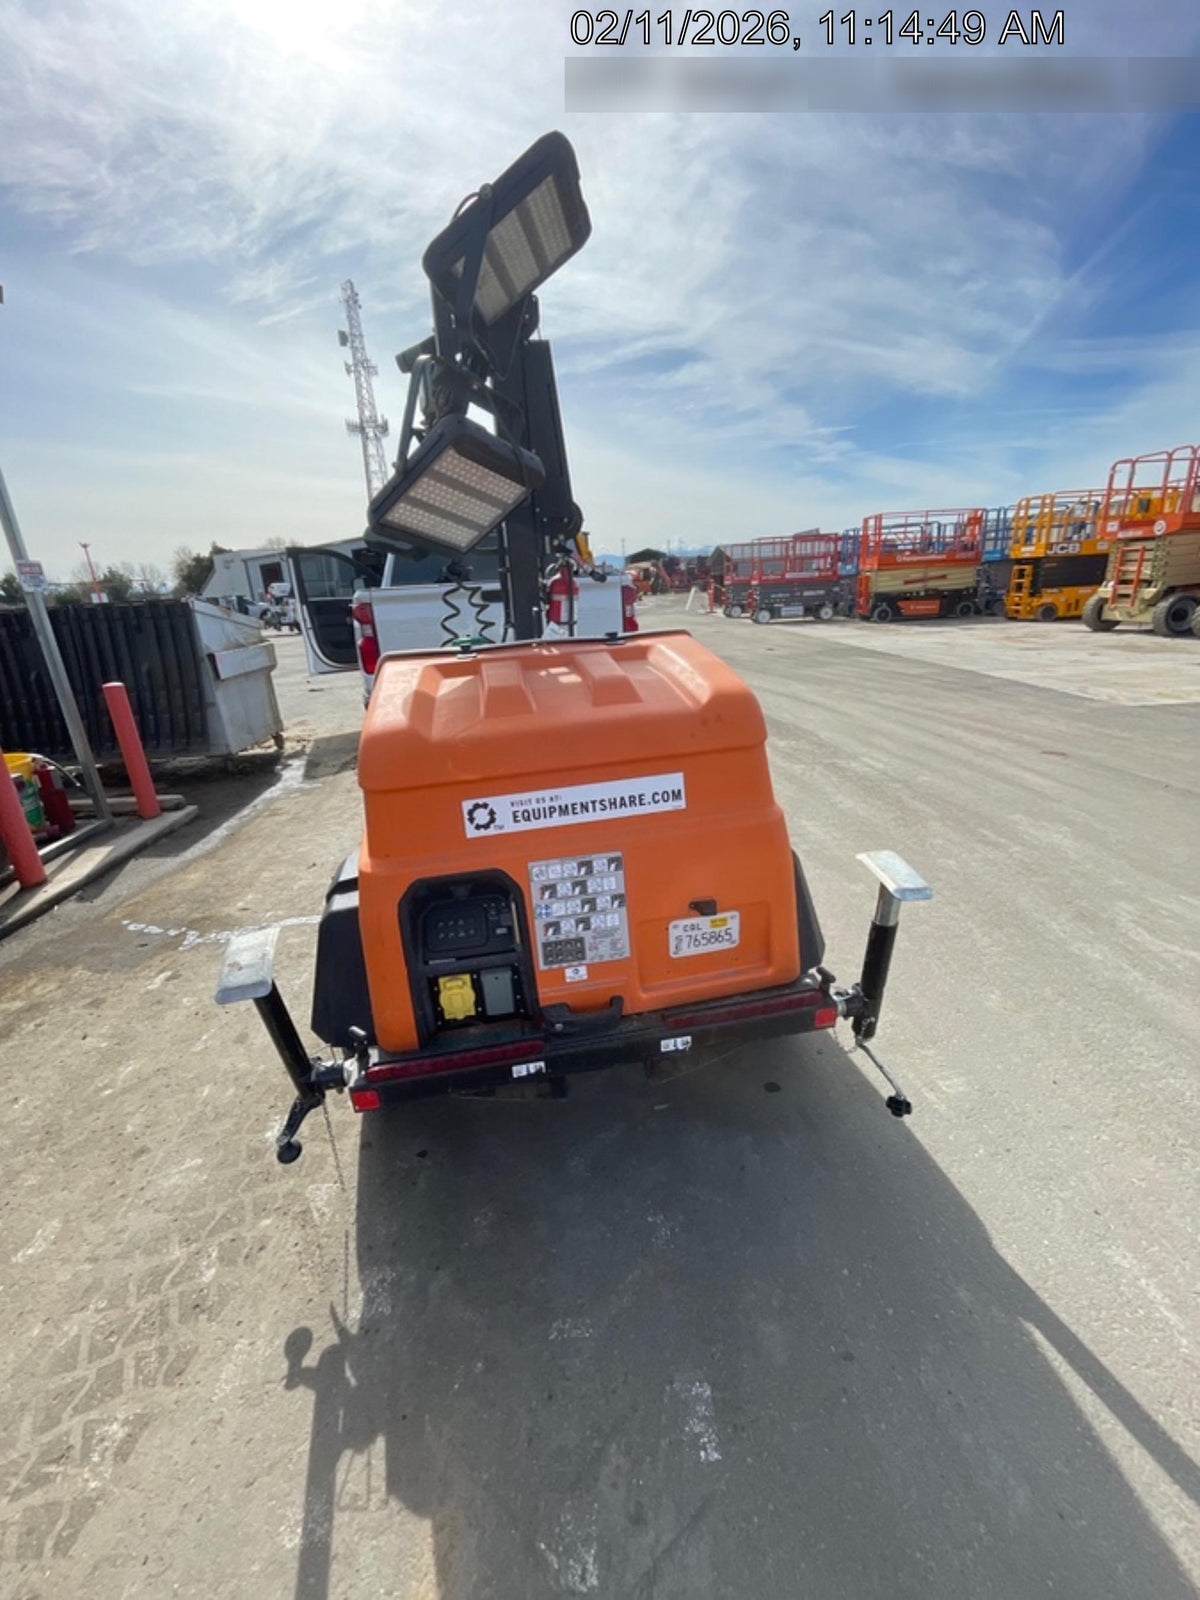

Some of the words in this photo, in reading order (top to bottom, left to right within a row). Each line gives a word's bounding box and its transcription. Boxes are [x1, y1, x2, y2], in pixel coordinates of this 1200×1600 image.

[1047, 543, 1080, 555] JCB
[512, 789, 682, 823] EQUIPMENTSHARE.COM
[686, 927, 733, 949] 765865
